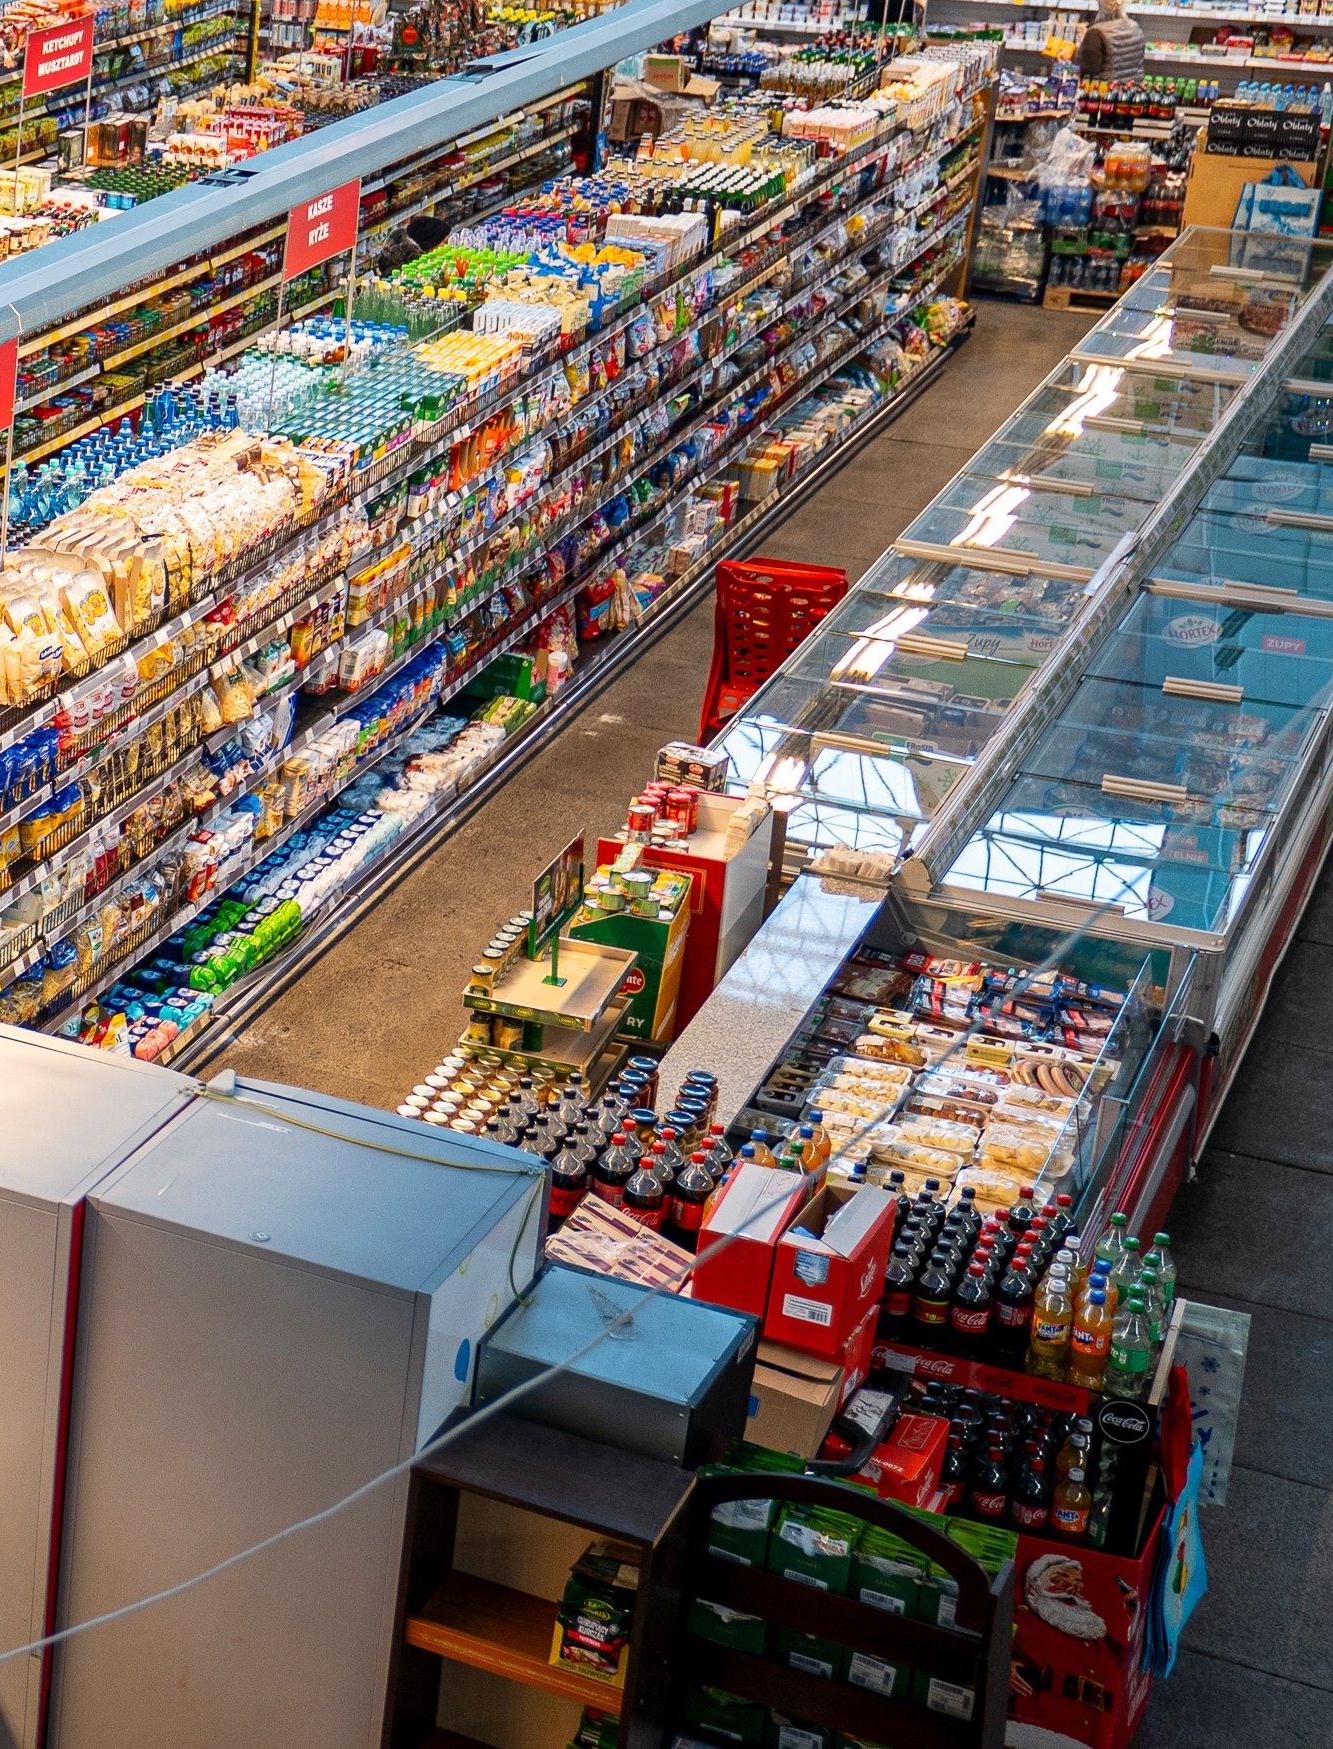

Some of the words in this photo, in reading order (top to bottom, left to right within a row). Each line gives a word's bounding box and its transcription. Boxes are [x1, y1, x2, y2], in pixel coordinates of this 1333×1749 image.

[42, 30, 84, 55] KETCHUPY
[38, 50, 84, 77] MUSZTARDY
[1211, 113, 1241, 128] Oblaty
[1247, 118, 1278, 131] Oblaty
[1283, 120, 1314, 134] Oblaty
[307, 194, 333, 222] KASZE
[308, 221, 330, 247] RYŻE
[1169, 624, 1216, 641] HORTEX
[965, 633, 1000, 654] Zupy
[1266, 637, 1302, 650] ZUPY
[626, 976, 642, 986] nte
[626, 1016, 645, 1029] RY
[951, 1307, 989, 1327] Coca-Cola
[1037, 1322, 1065, 1335] FANTA
[914, 1354, 956, 1375] Coca-Cola
[1101, 1412, 1144, 1433] Coca-Cola
[972, 1490, 1007, 1510] Coca-Cola
[1054, 1507, 1080, 1522] FANTA
[578, 1625, 606, 1643] KURCZAK
